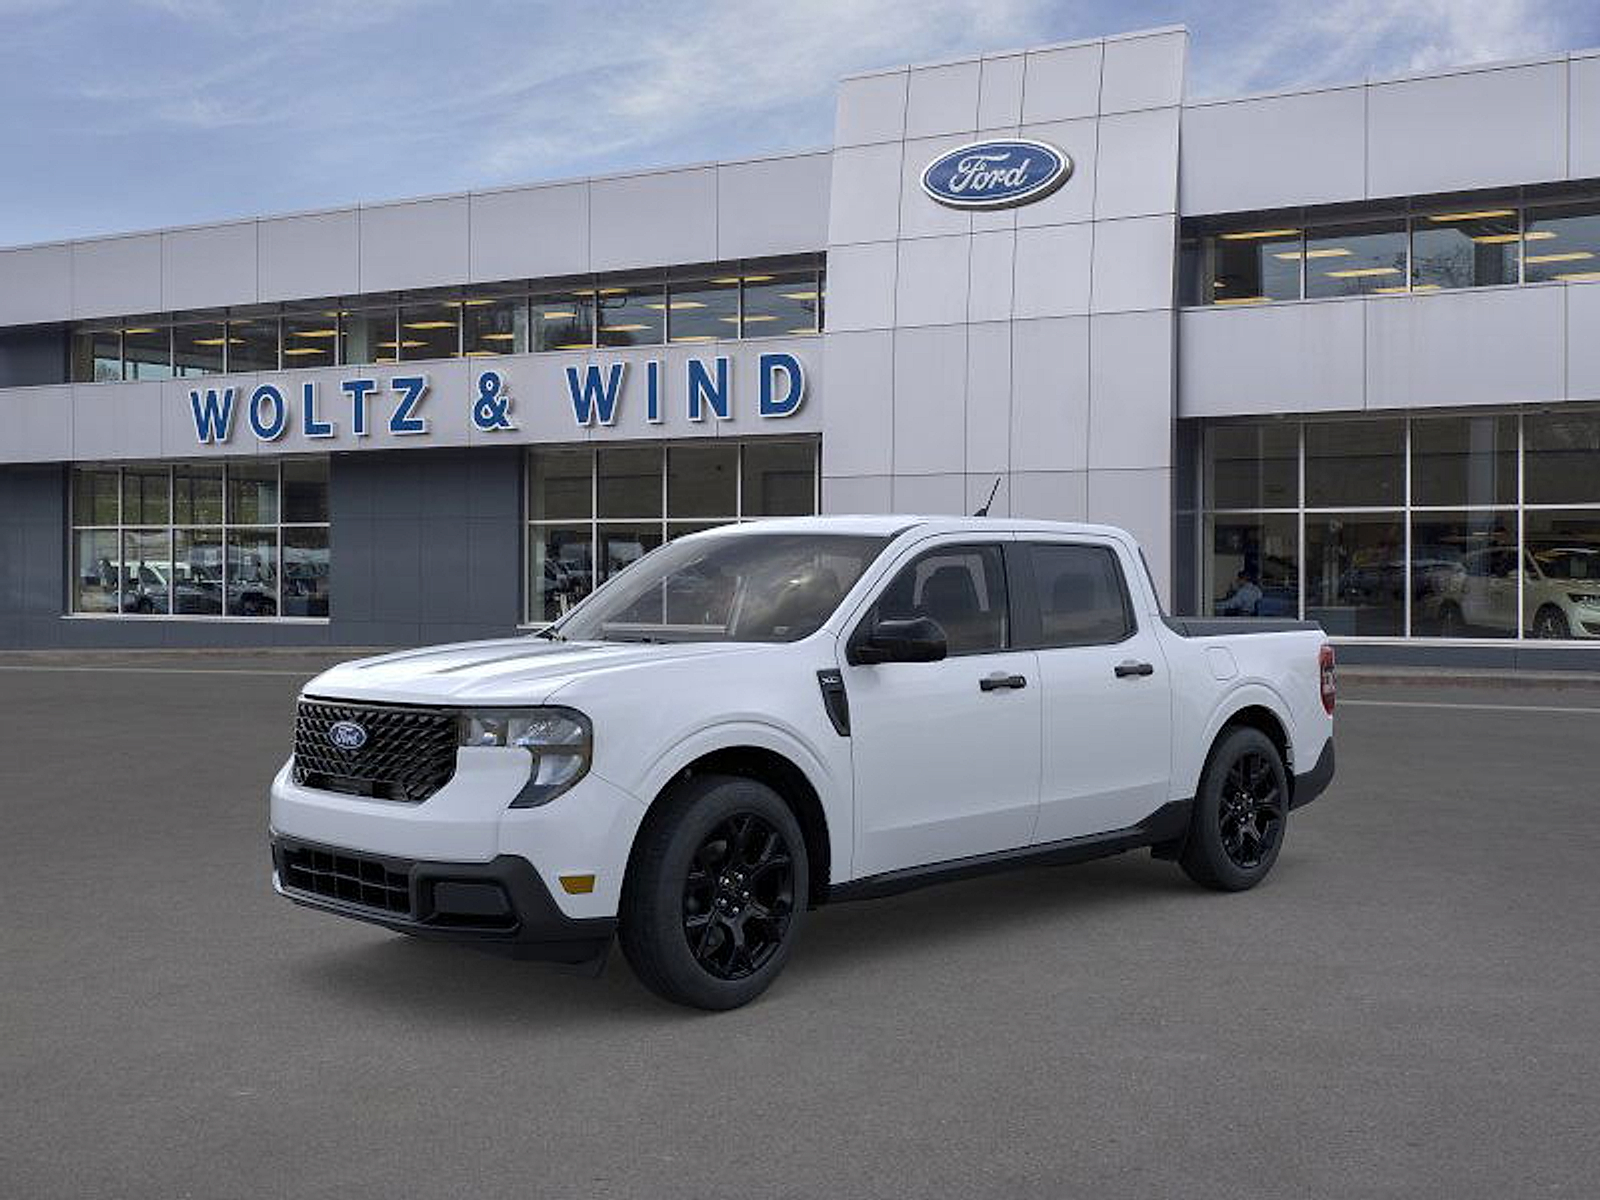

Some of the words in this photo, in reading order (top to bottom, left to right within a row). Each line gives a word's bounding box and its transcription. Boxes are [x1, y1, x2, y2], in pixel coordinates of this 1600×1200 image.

[950, 152, 1031, 193] Ford
[190, 376, 429, 443] WOLTZ
[472, 370, 513, 430] &
[566, 352, 805, 425] WIND
